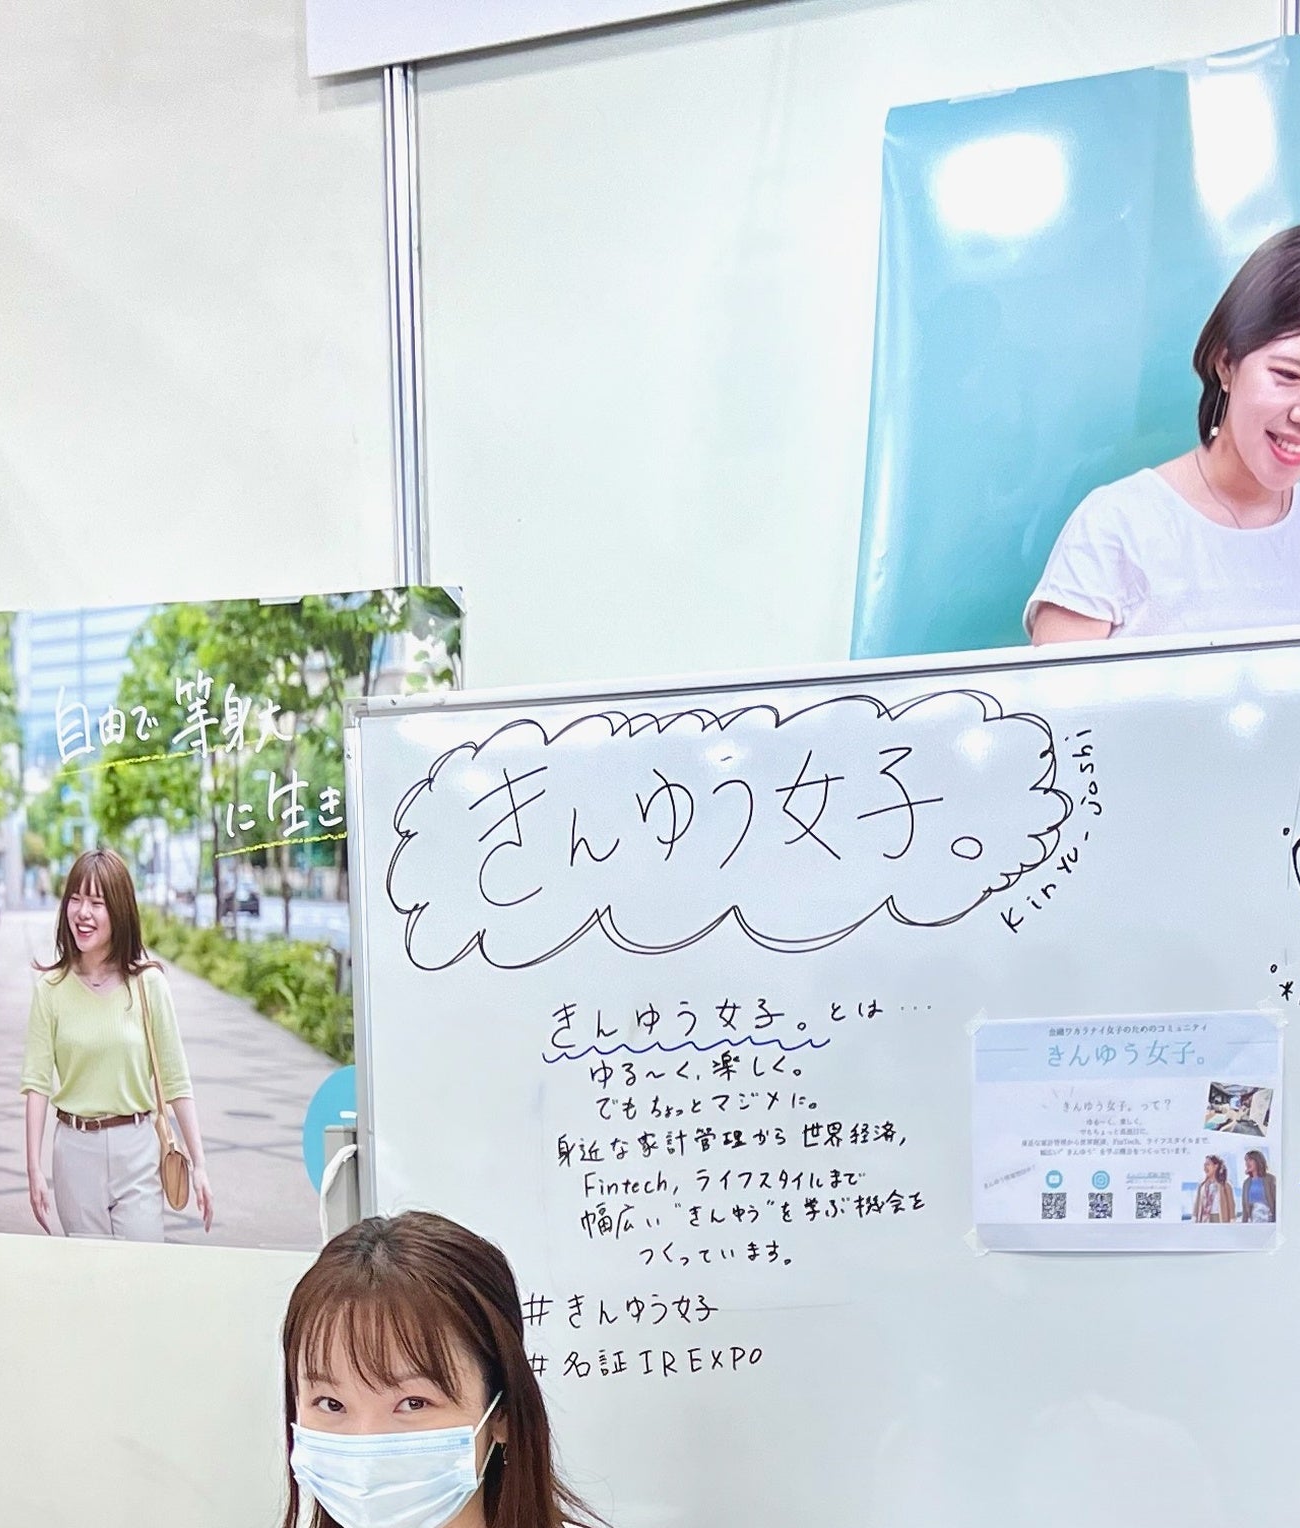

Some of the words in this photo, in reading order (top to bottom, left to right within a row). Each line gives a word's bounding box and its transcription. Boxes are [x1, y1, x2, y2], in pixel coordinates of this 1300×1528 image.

[56, 670, 293, 764] 自由で等身大
[468, 746, 985, 908] きんゆう女子。
[1047, 1039, 1205, 1067] きんゆう女子。
